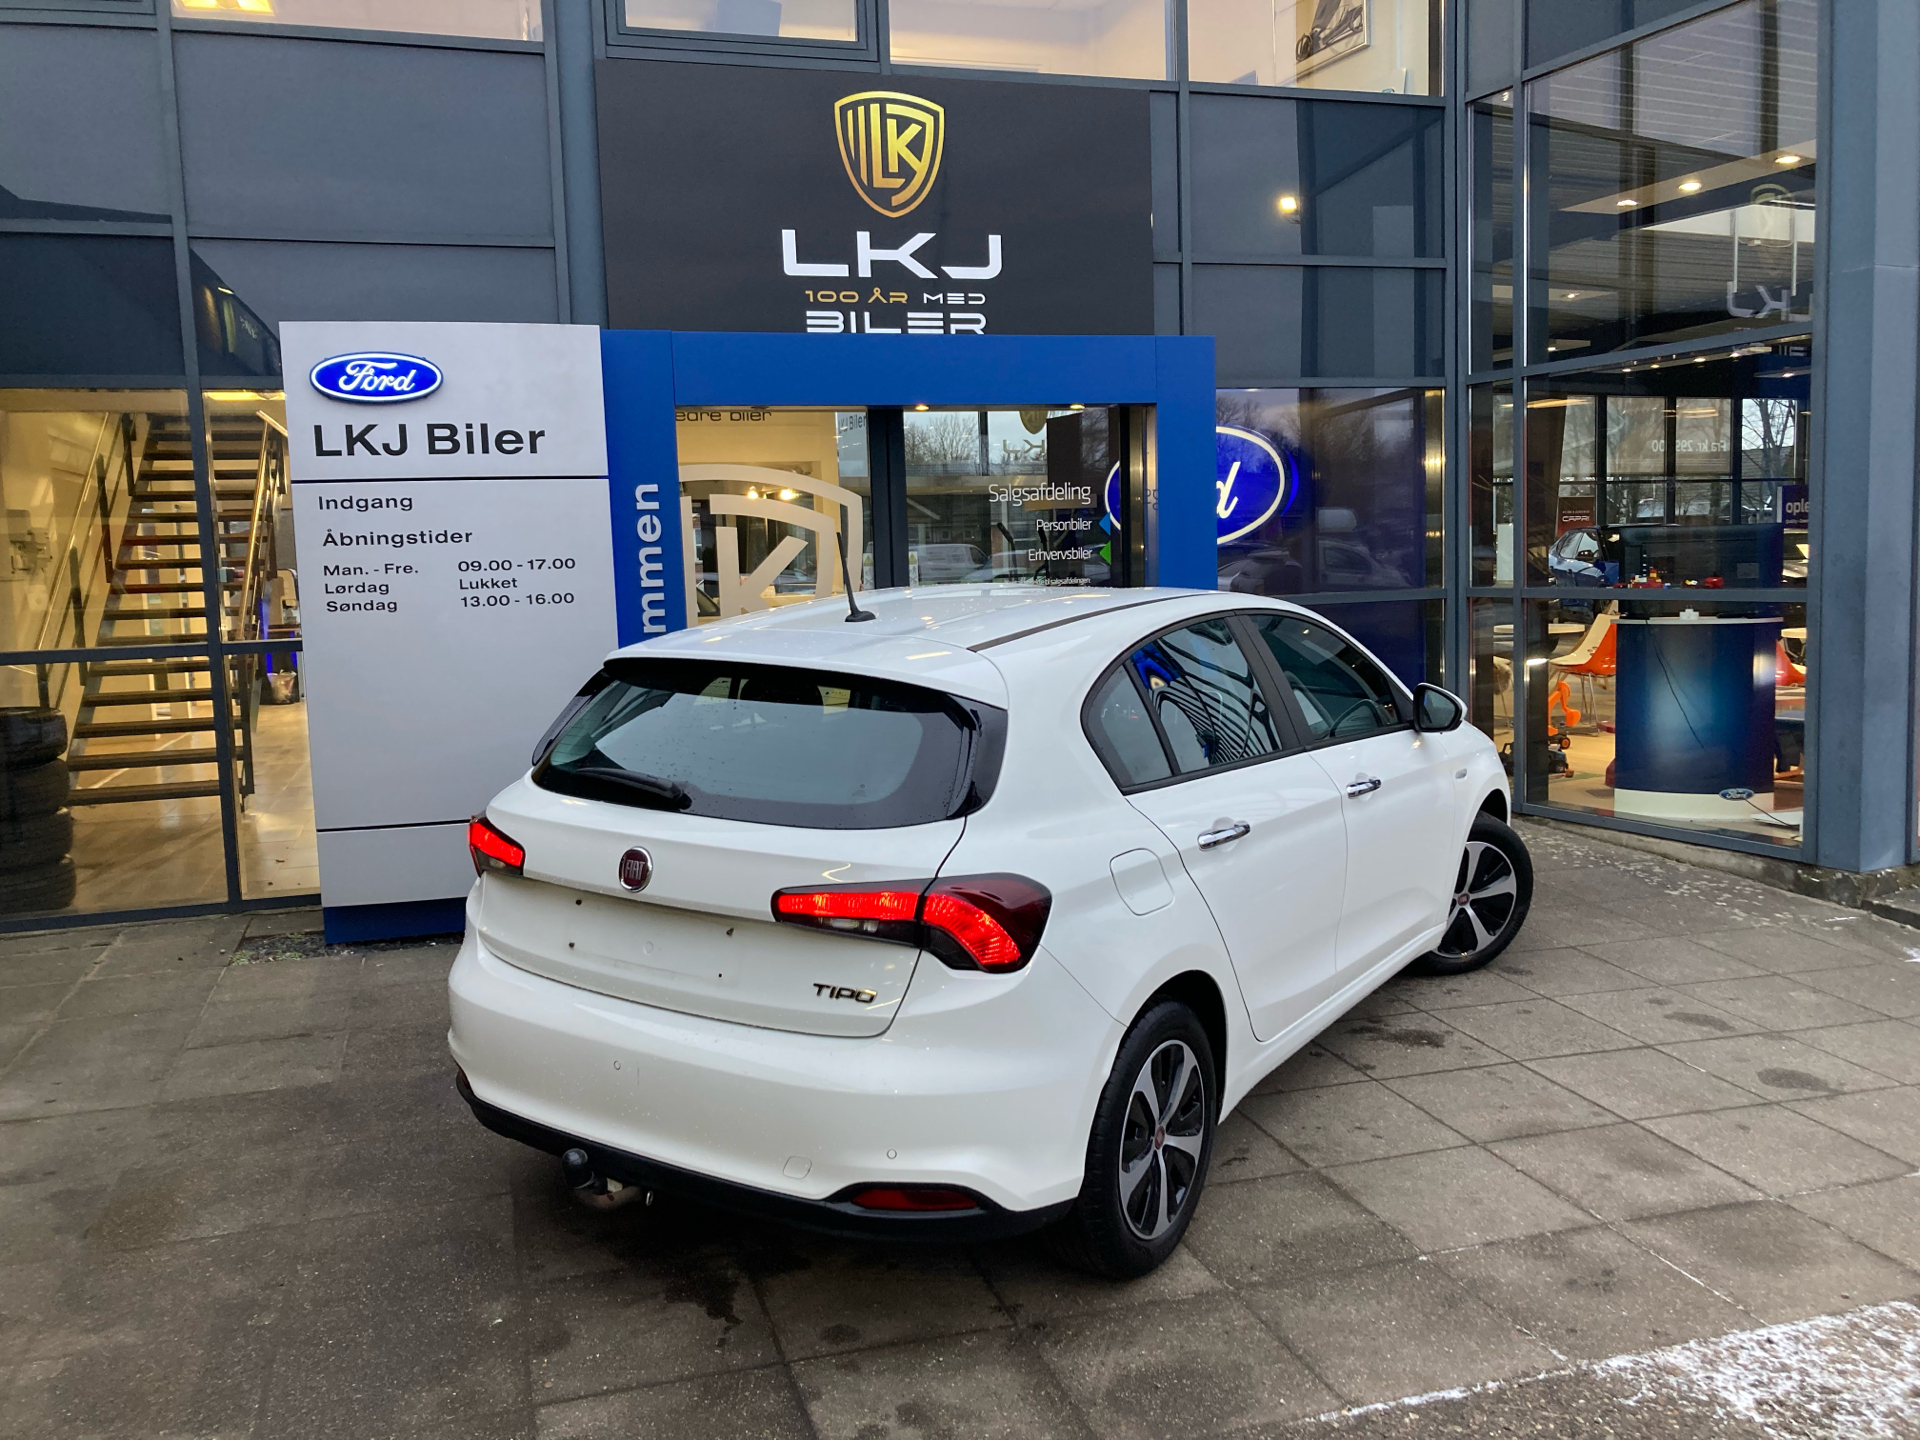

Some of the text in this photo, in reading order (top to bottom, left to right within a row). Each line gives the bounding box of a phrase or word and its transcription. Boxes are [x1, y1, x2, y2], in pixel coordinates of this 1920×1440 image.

[782, 229, 1002, 280] LKJ
[805, 287, 986, 305] 100 ÅR MED
[806, 310, 987, 334] BILER
[338, 360, 417, 391] Ford
[313, 423, 546, 457] LKJ Biler
[988, 482, 1091, 507] Salgsafdeling
[318, 495, 413, 512] Indgang
[1036, 518, 1093, 531] Personbiler
[322, 528, 473, 548] Åbningstider
[635, 483, 667, 634] mmen
[1028, 547, 1093, 561] Erhvervsbiler
[323, 564, 369, 577] Man.
[384, 563, 419, 575] Fre.
[458, 559, 513, 572] 09.00
[527, 557, 576, 570] 17.00
[324, 582, 390, 595] Lørdag
[459, 577, 518, 590] Lukket
[326, 599, 398, 613] Søndag
[460, 594, 511, 607] 13.00
[525, 592, 575, 606] 16.00
[813, 982, 878, 1004] TIPO
